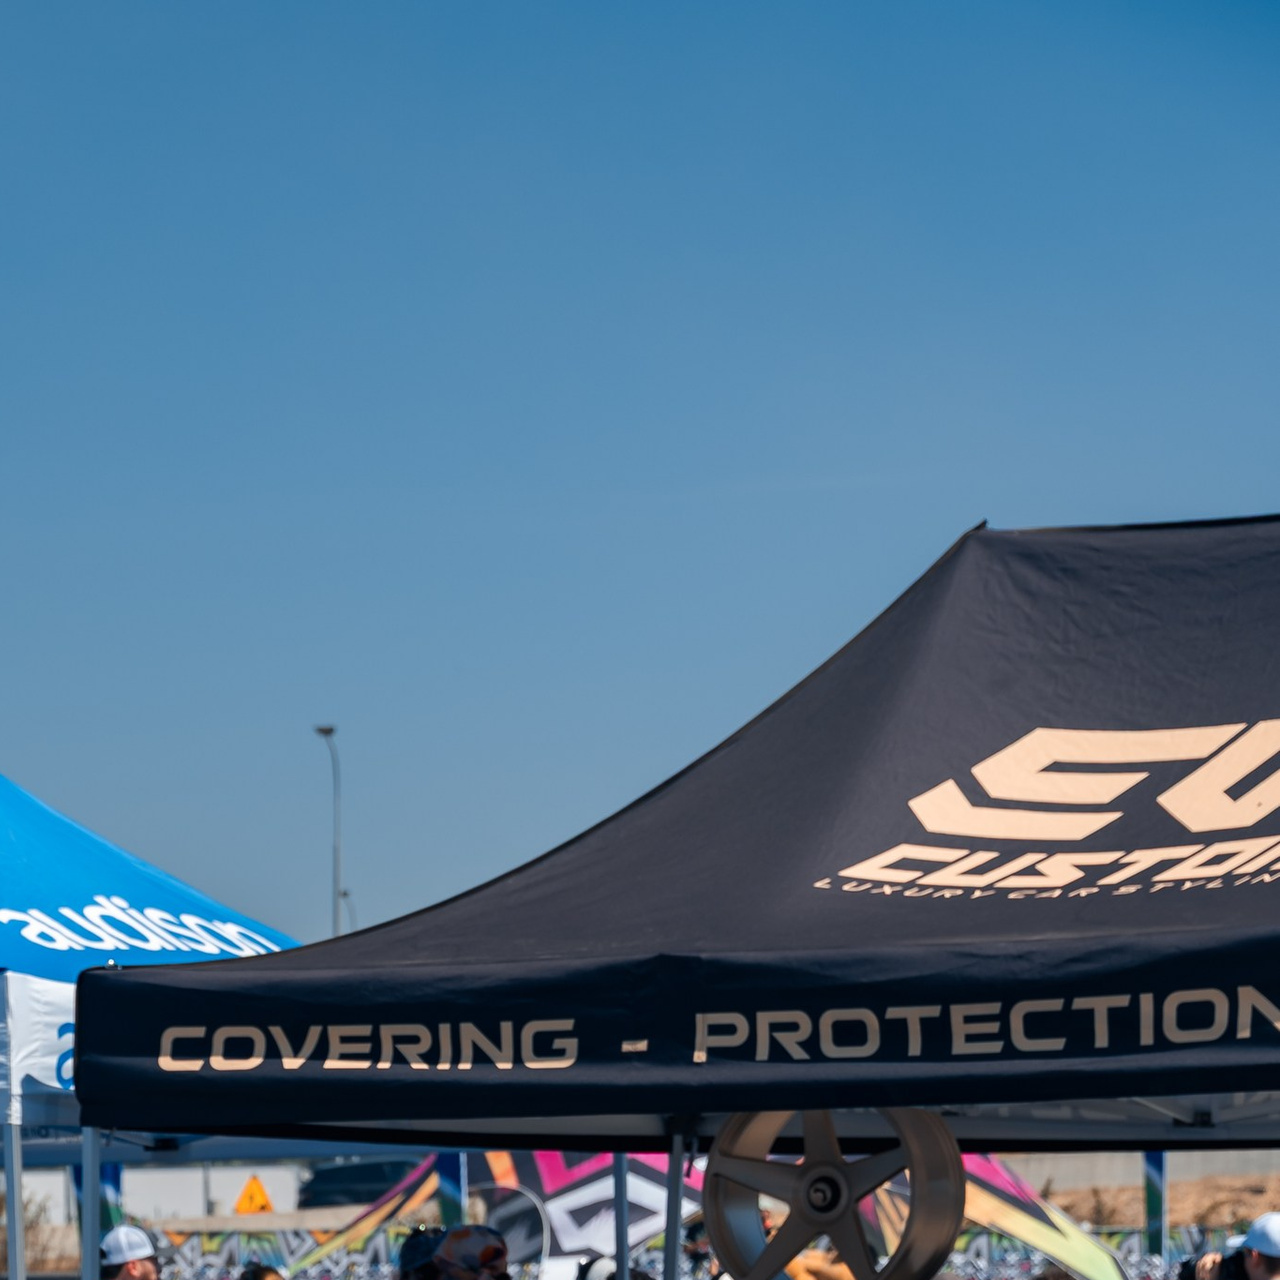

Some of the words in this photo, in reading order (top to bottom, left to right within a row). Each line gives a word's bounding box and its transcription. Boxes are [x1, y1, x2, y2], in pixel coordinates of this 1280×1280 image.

[813, 876, 996, 899] LUXURY
[1007, 885, 1100, 899] CAR
[1112, 870, 1280, 896] STYLIN
[157, 1019, 579, 1072] COVERING
[693, 985, 1280, 1063] PROTECTION
